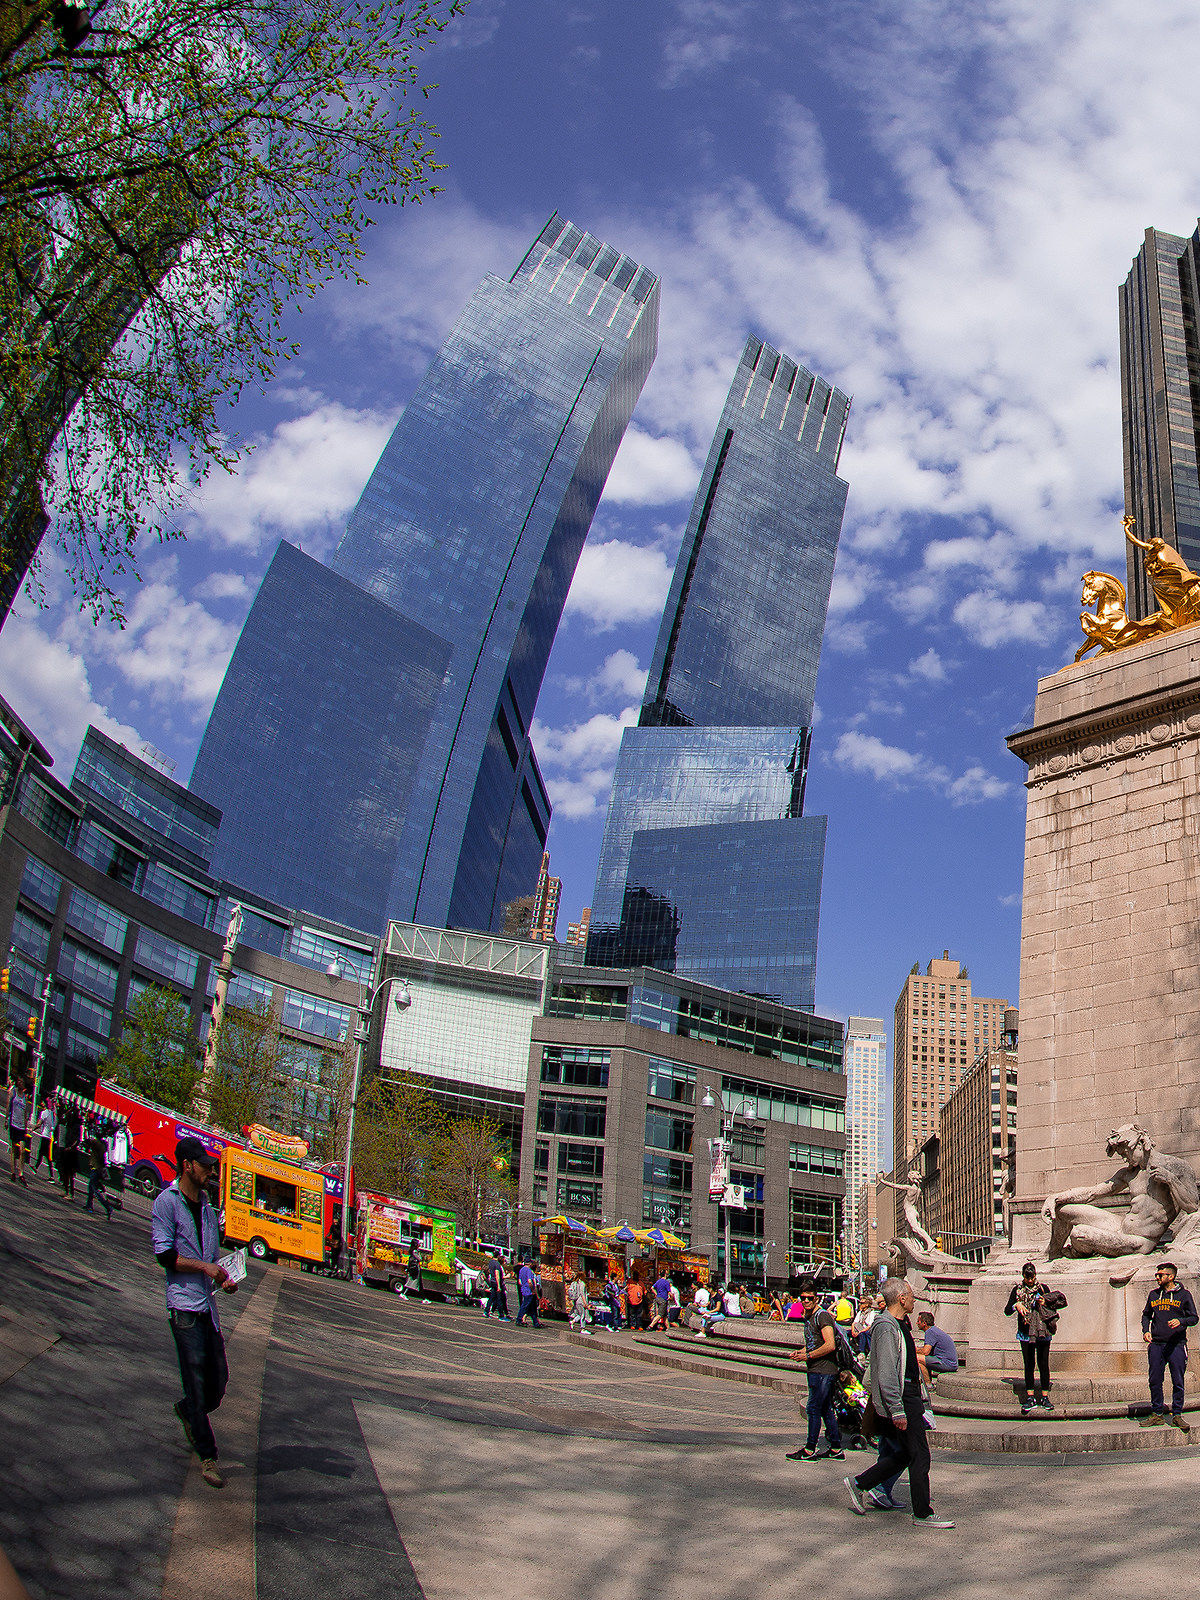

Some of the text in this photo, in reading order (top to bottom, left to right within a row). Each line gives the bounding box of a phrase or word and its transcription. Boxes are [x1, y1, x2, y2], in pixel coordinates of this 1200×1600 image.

[264, 1165, 290, 1178] ORIGINAL
[291, 1173, 308, 1183] SINCE
[570, 1193, 592, 1202] BOSS
[654, 1205, 676, 1216] BOSS
